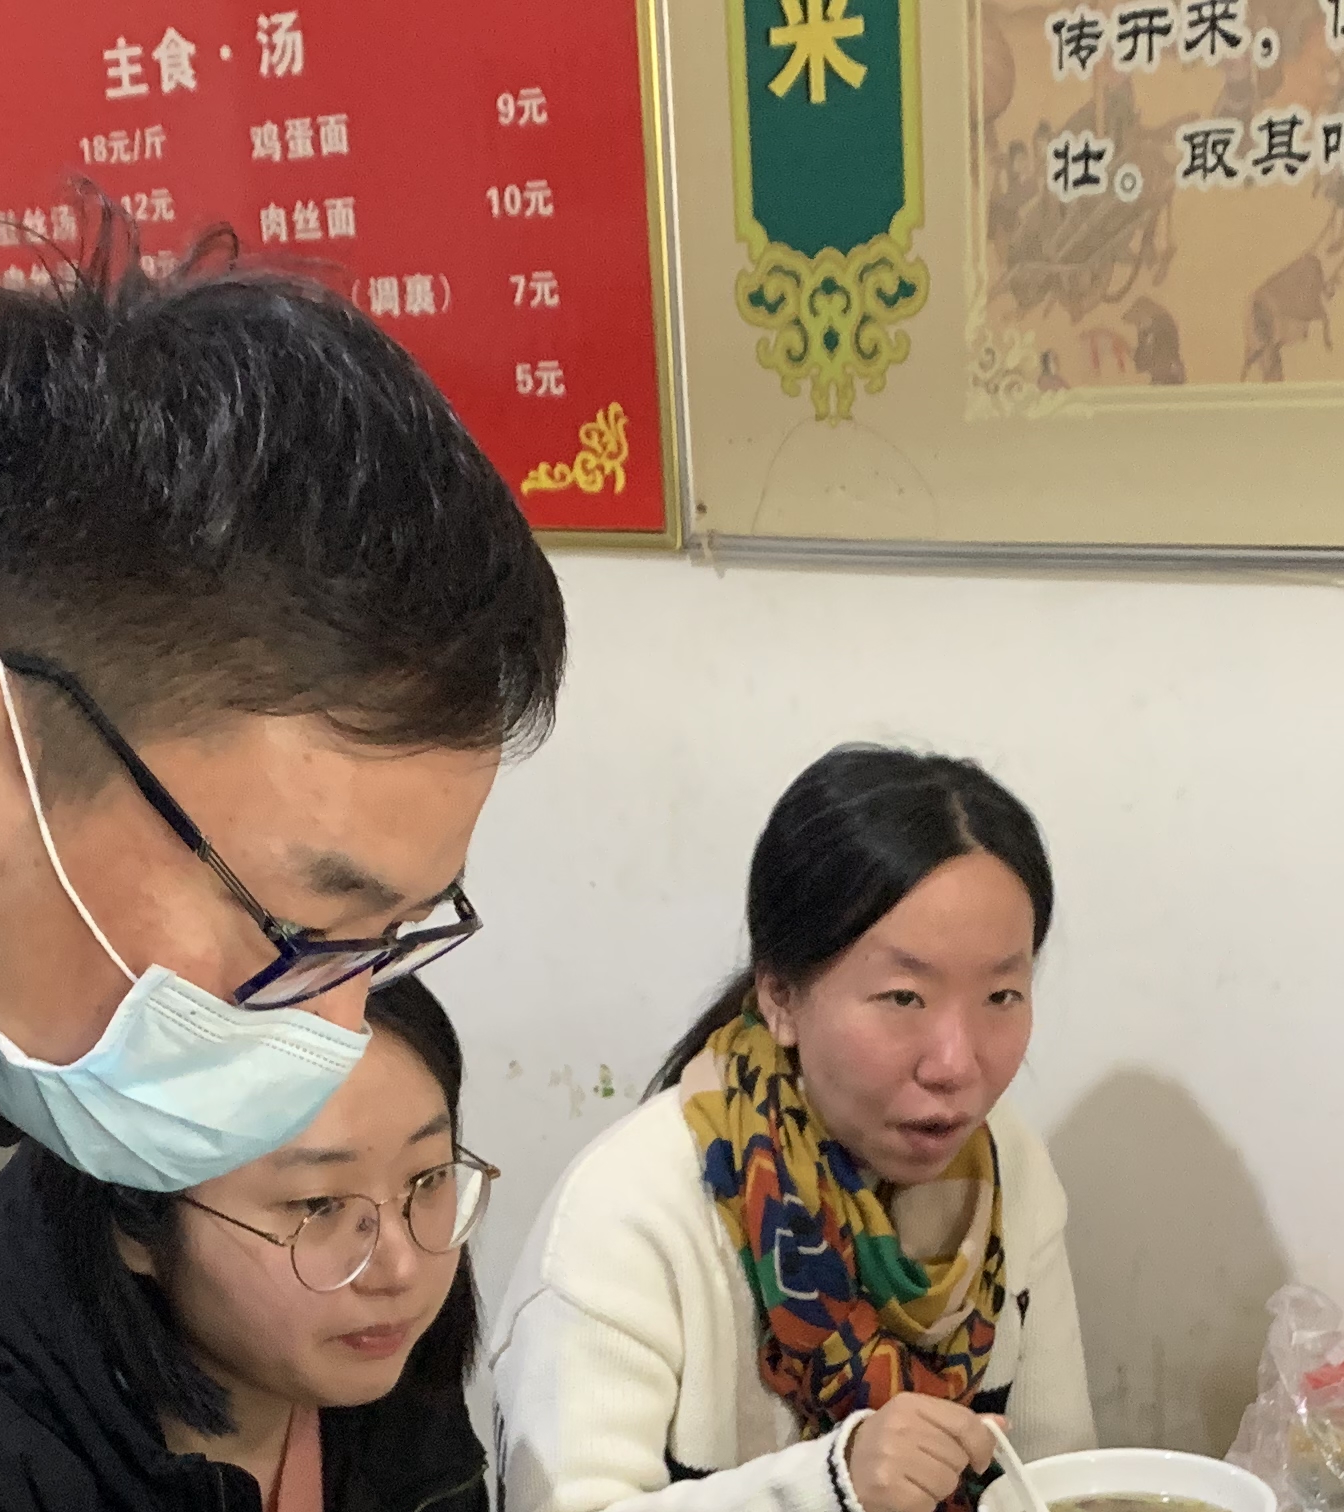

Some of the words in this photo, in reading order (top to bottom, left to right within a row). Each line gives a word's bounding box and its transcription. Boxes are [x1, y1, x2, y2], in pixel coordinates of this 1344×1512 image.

[79, 124, 167, 165] 18元/斤
[250, 113, 350, 164] 鸡蛋面
[496, 87, 548, 127] 9元
[120, 187, 176, 223] 12元
[259, 196, 356, 245] 肉丝面
[485, 179, 554, 218] 10元
[509, 270, 560, 309] 7元
[515, 360, 567, 399] 5元
